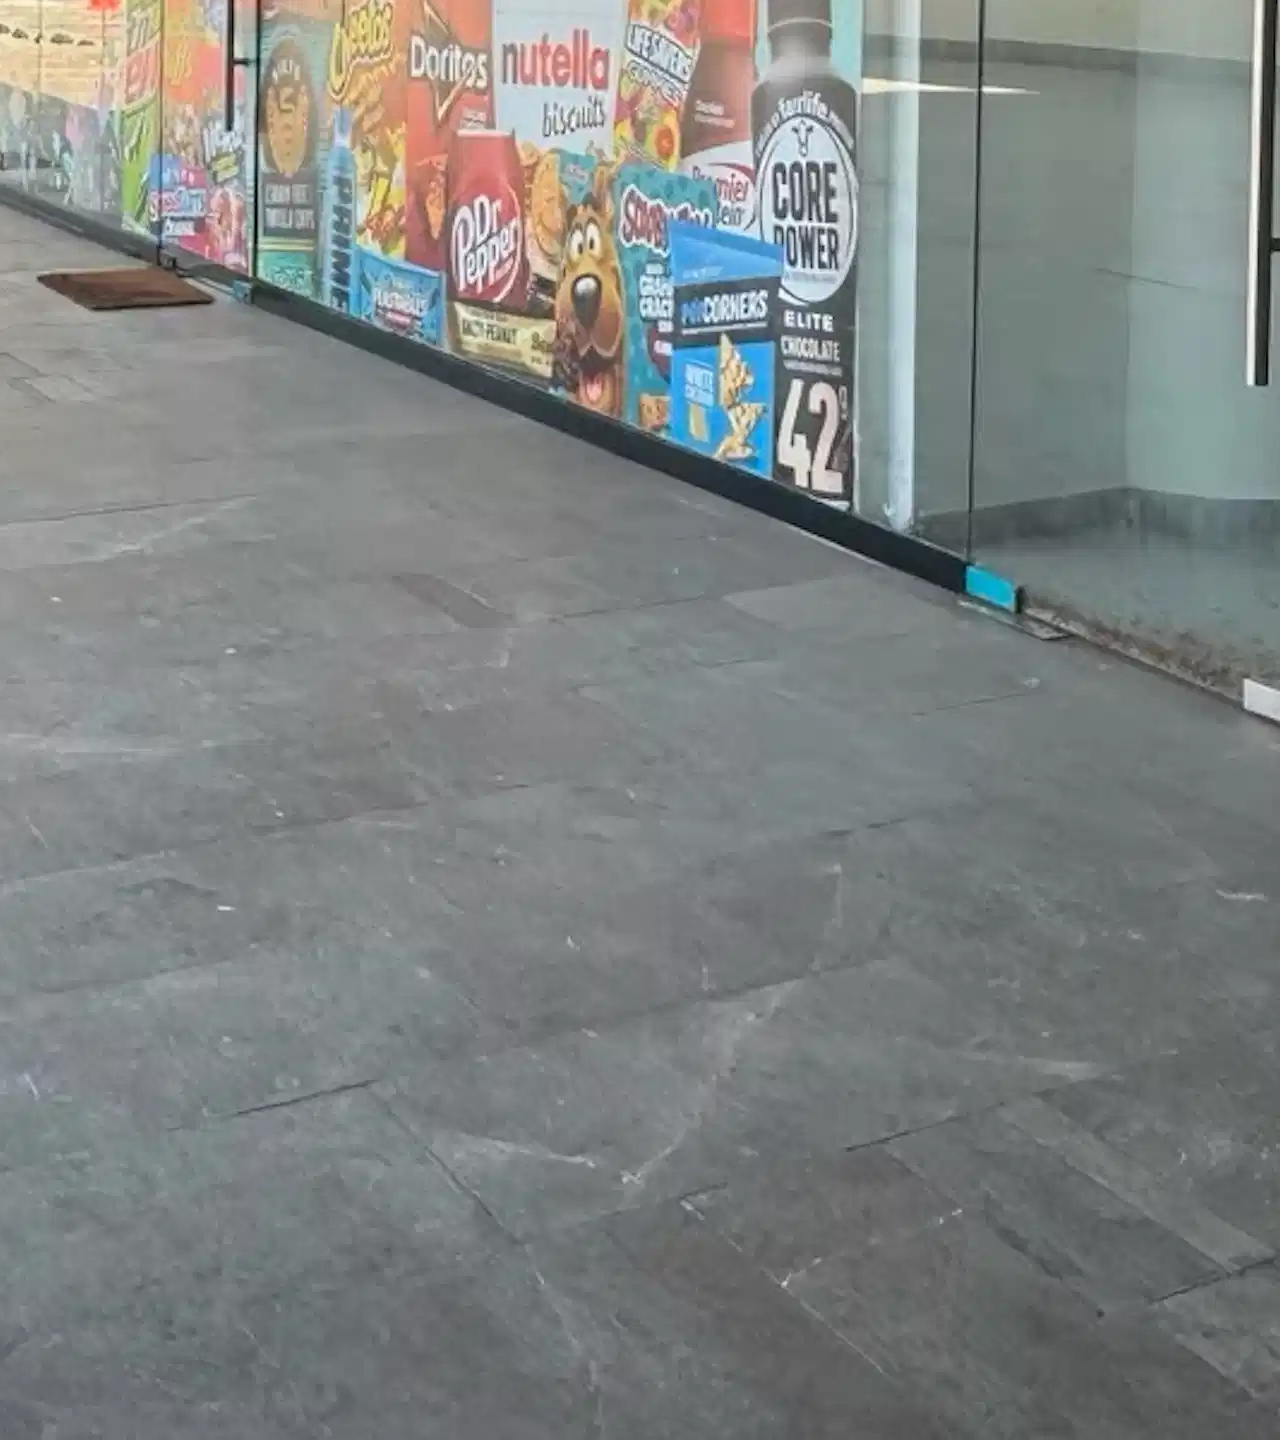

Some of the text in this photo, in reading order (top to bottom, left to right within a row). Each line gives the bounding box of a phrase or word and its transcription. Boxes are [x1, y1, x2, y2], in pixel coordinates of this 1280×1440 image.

[410, 35, 488, 89] Doritos
[501, 27, 610, 90] nutella
[541, 95, 607, 138] biscuits
[772, 161, 839, 224] CORE
[474, 194, 503, 244] Dr
[451, 206, 519, 296] Pepper
[783, 309, 834, 333] ELITE
[780, 335, 841, 363] CHOCOLATE
